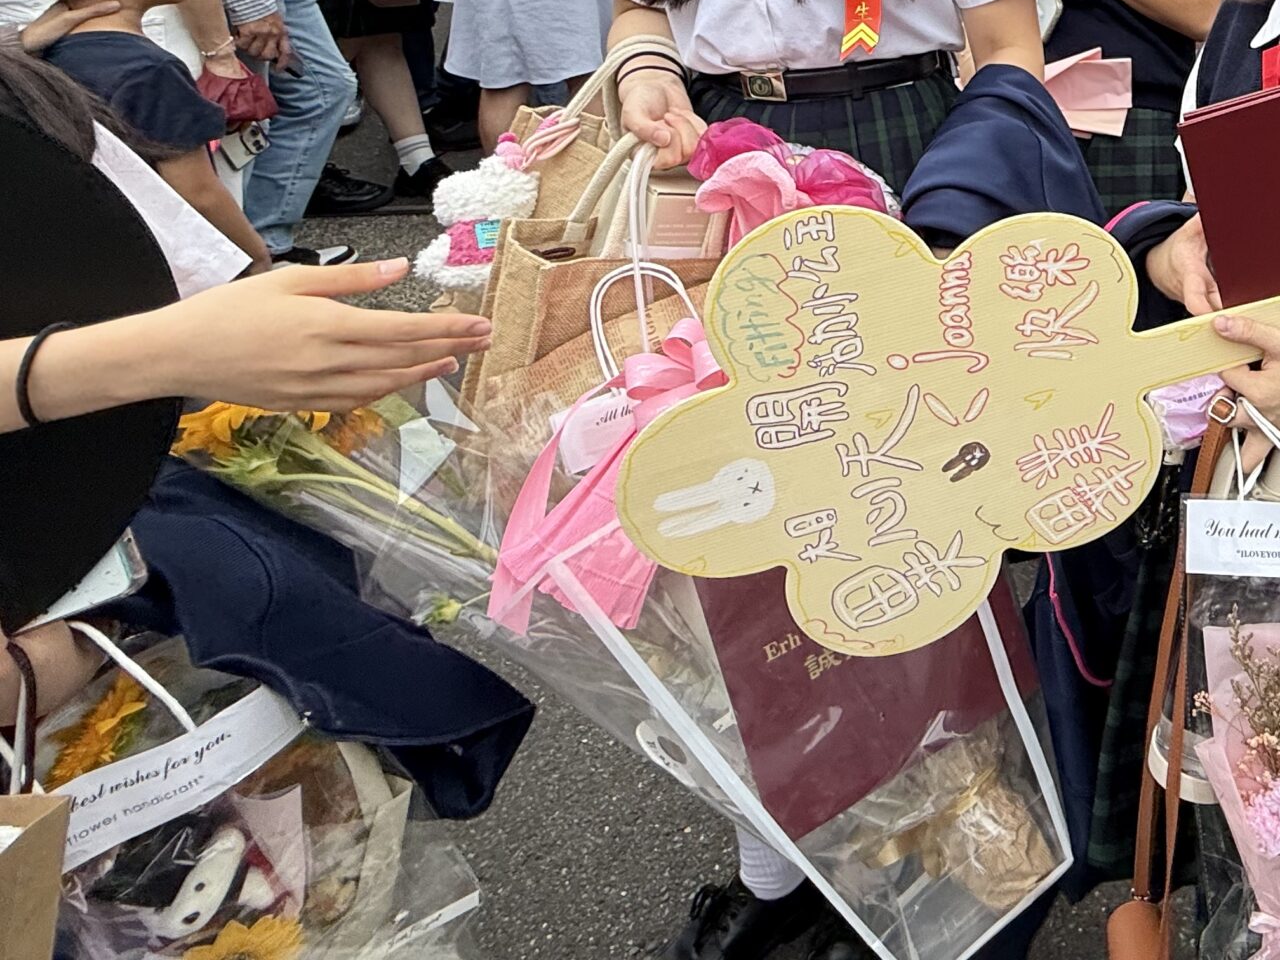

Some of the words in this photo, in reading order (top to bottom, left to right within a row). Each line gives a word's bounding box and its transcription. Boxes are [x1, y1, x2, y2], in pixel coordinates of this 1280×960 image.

[620, 404, 635, 419] th
[1204, 518, 1236, 538] You
[1238, 520, 1274, 539] had
[763, 633, 803, 663] Erh
[109, 769, 161, 795] wishes
[162, 756, 191, 780] for
